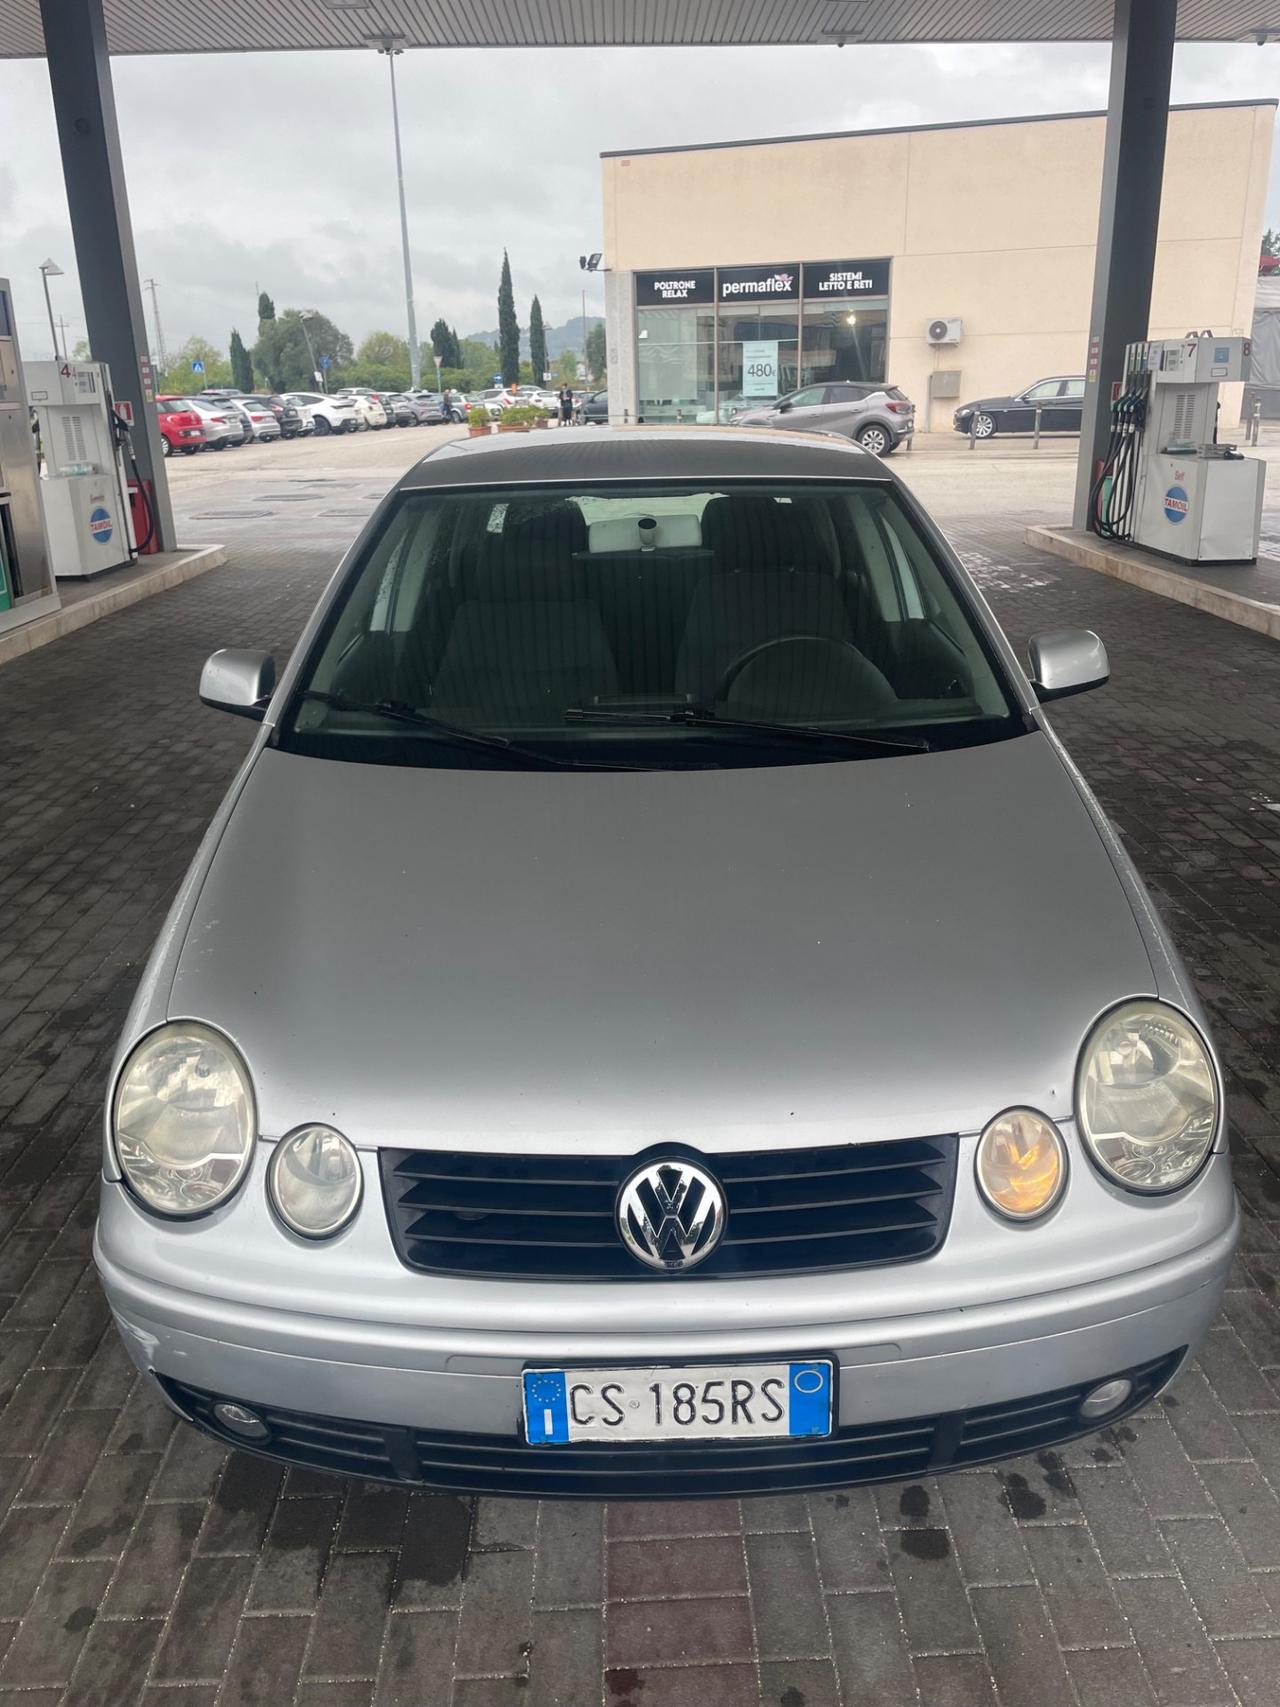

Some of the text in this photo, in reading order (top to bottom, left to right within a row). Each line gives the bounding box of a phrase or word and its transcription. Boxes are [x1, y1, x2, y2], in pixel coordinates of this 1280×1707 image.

[829, 272, 862, 281] SISTEMI
[654, 280, 696, 290] POLTRONE
[722, 278, 792, 296] permaflex
[819, 280, 872, 290] LETTO E RETI
[662, 290, 688, 298] RELAX
[1187, 343, 1197, 357] 7
[1243, 342, 1251, 357] 8
[60, 364, 71, 378] 4
[1164, 499, 1189, 512] TAMOIL
[569, 1378, 786, 1426] CS 185RS
